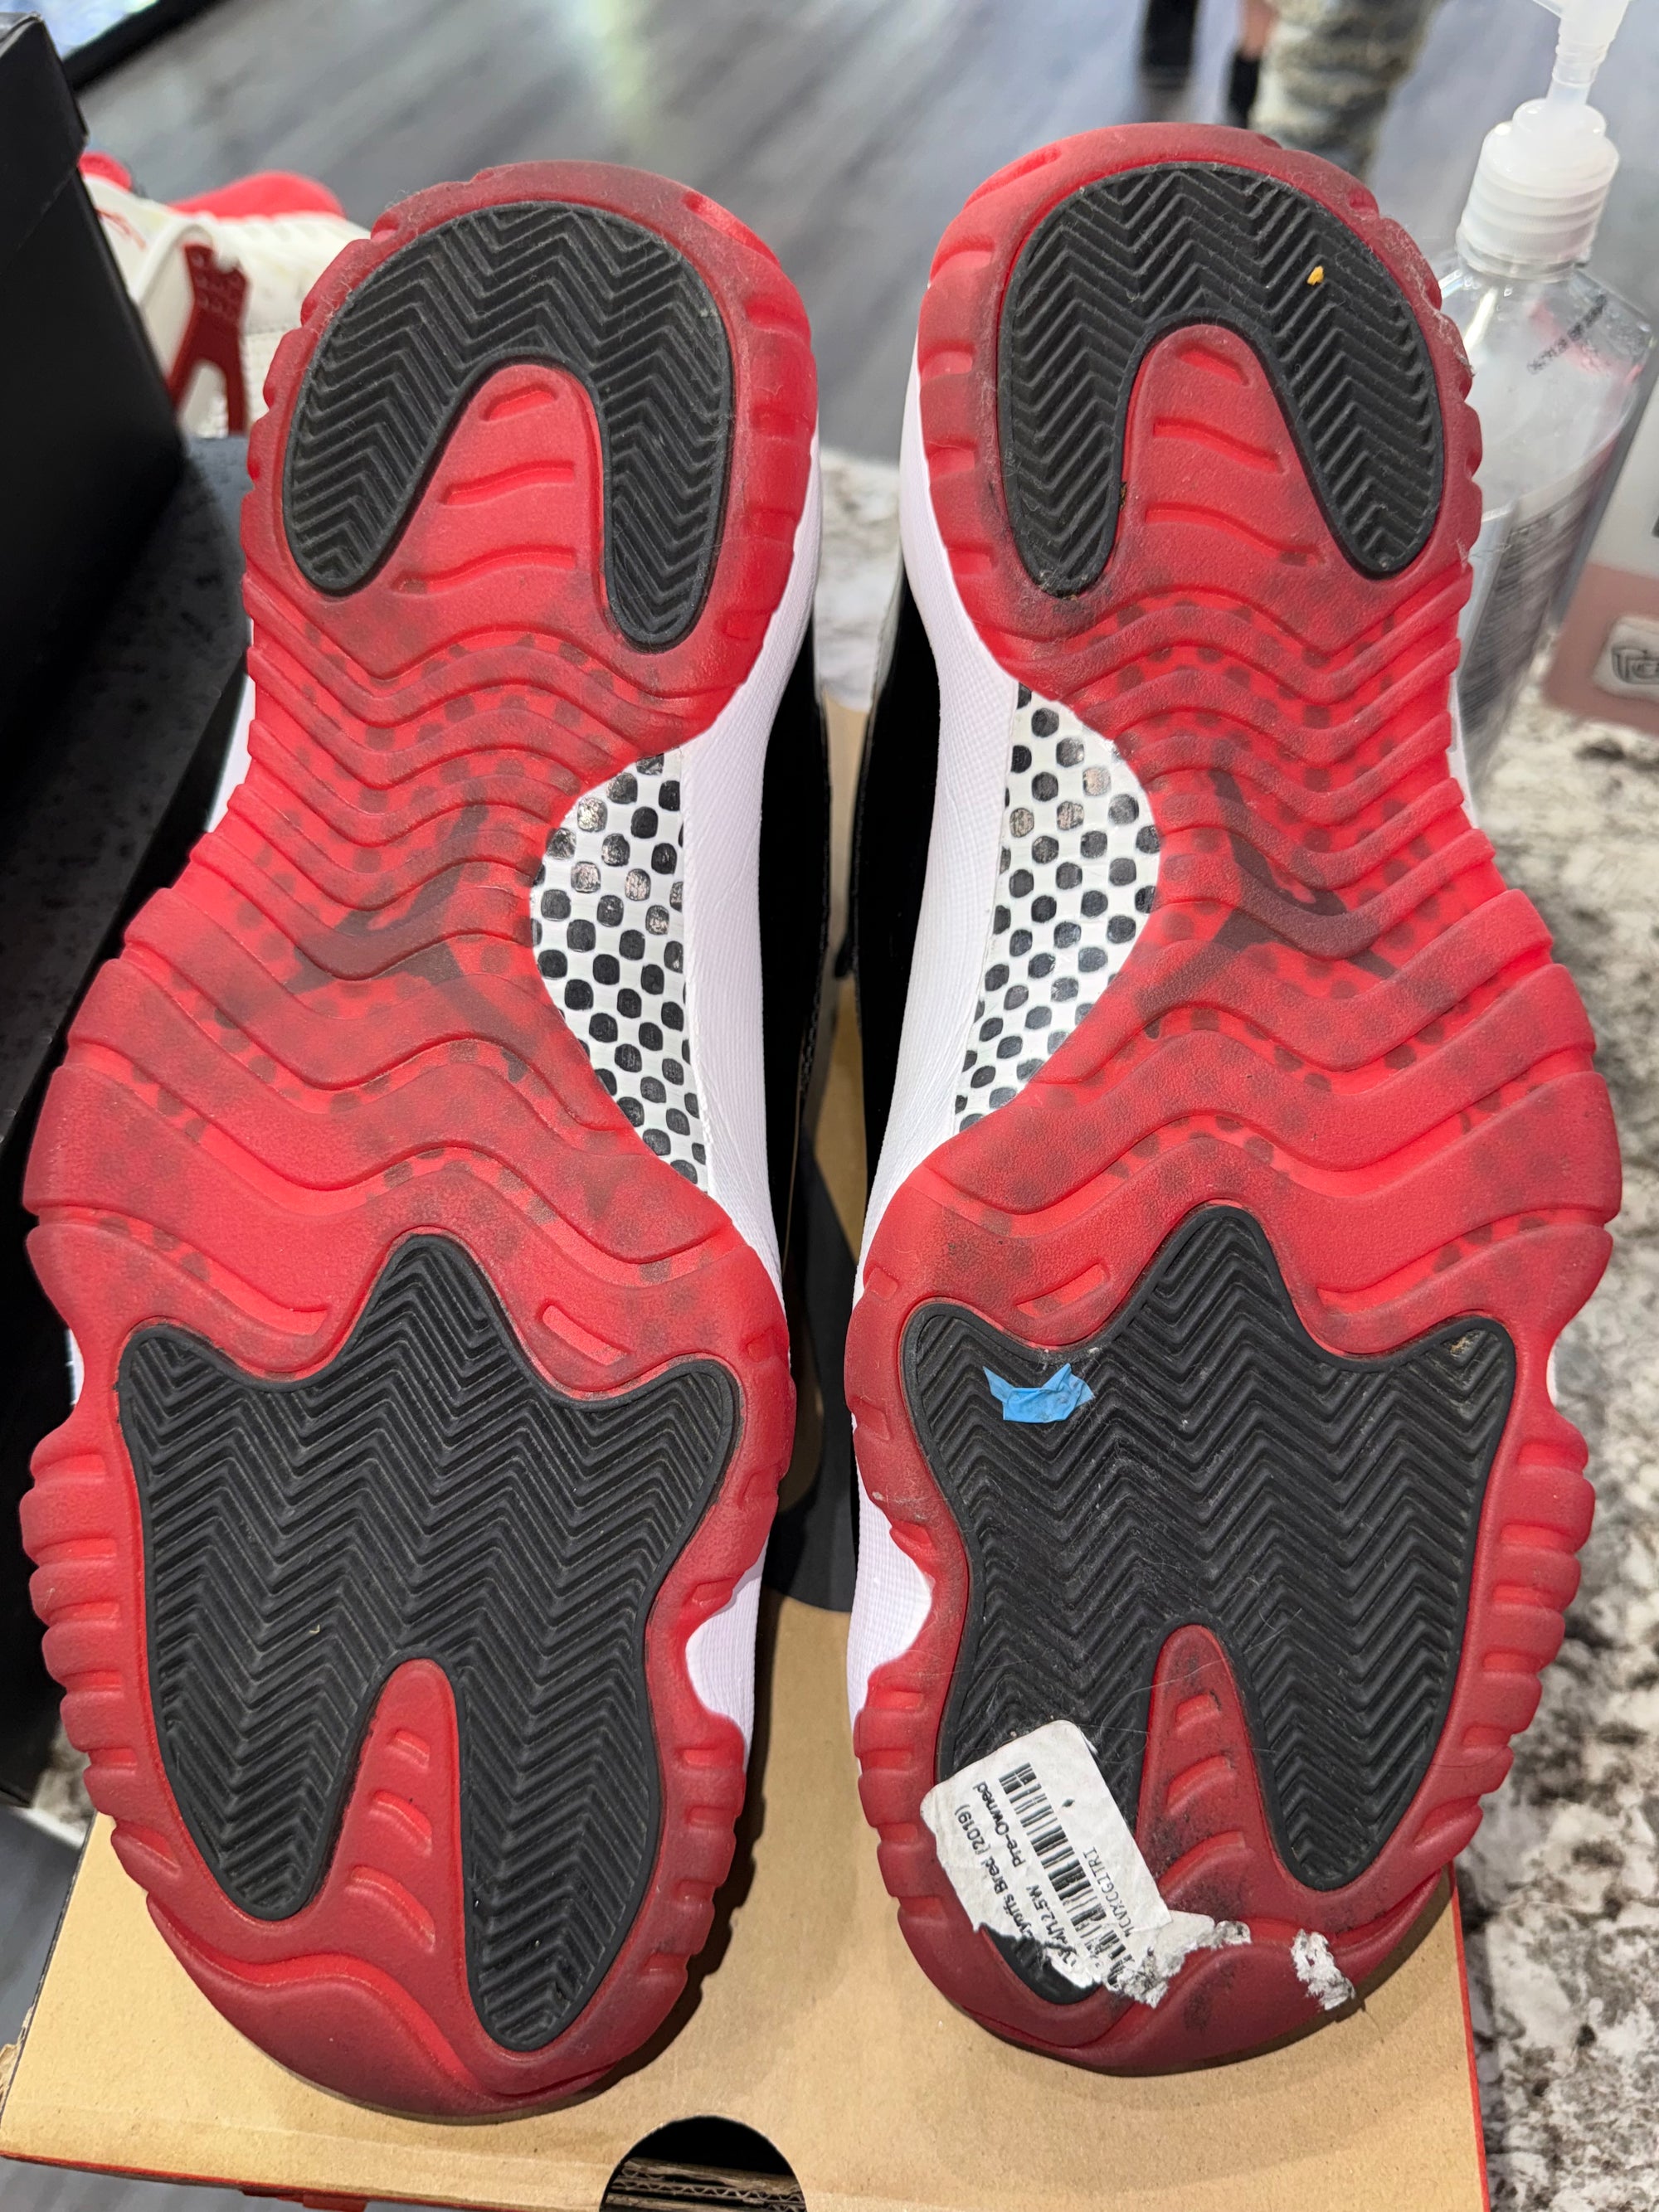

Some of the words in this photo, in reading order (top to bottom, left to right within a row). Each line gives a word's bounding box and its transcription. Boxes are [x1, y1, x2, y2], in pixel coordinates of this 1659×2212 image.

[952, 1801, 992, 1855] (2019)
[971, 1781, 1026, 1868] Pre-Owned
[980, 1855, 1010, 1895] Bred
